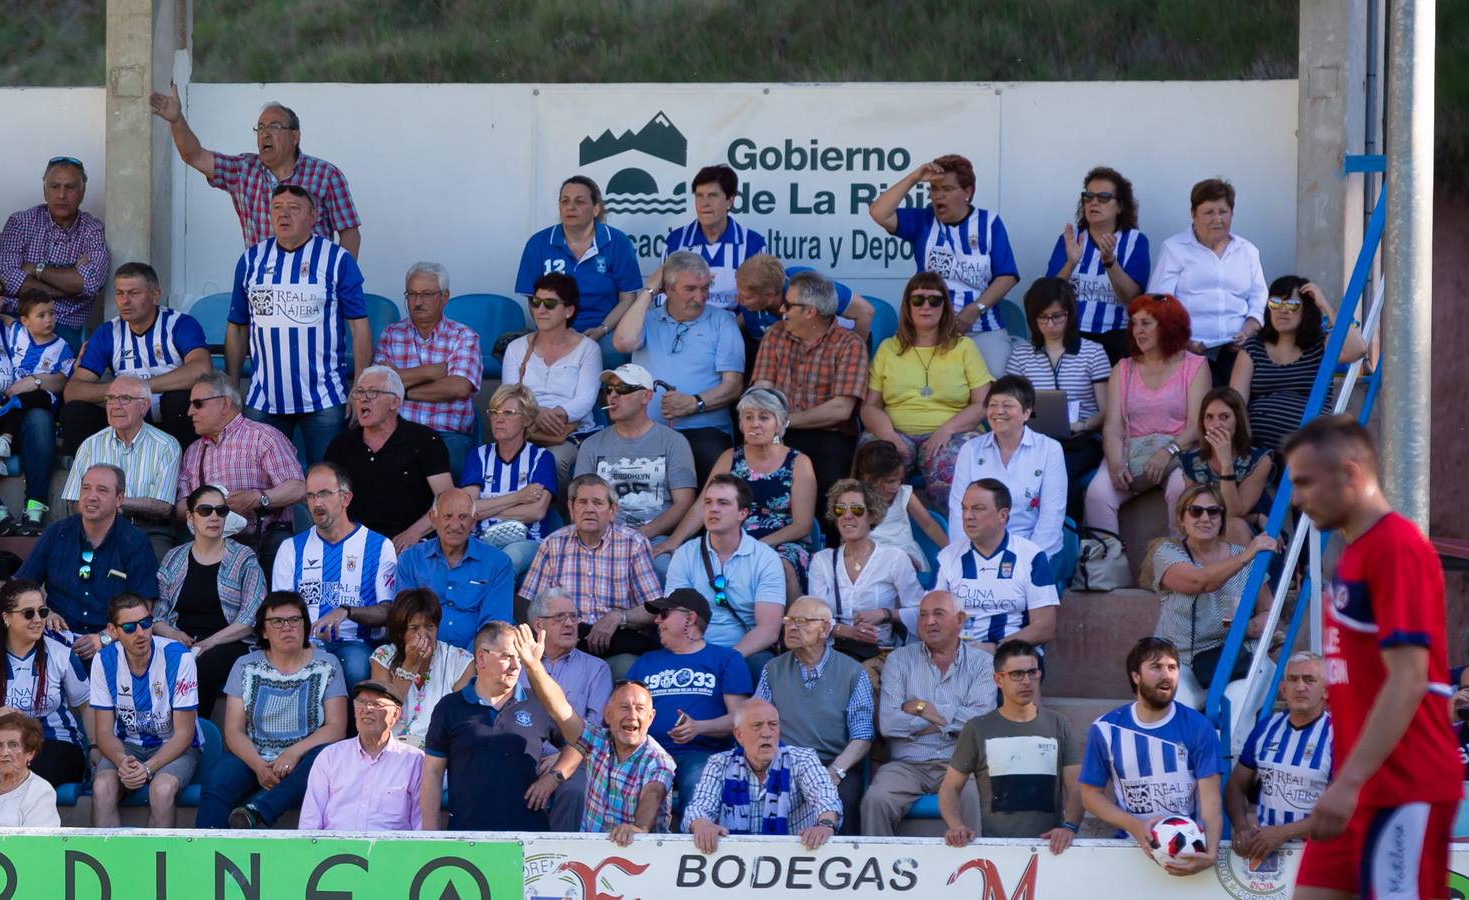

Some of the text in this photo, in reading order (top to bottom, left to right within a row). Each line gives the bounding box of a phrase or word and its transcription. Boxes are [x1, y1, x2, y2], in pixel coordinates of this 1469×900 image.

[728, 138, 911, 172] Gobierno
[730, 182, 776, 215] de
[789, 182, 836, 215] La
[765, 228, 821, 260] ltura
[829, 237, 843, 268] y
[851, 229, 915, 268] Depo
[544, 259, 566, 276] 12
[276, 291, 306, 302] REAL
[1151, 782, 1184, 796] REAL
[1276, 769, 1307, 786] REAL
[676, 854, 919, 892] BODEGAS
